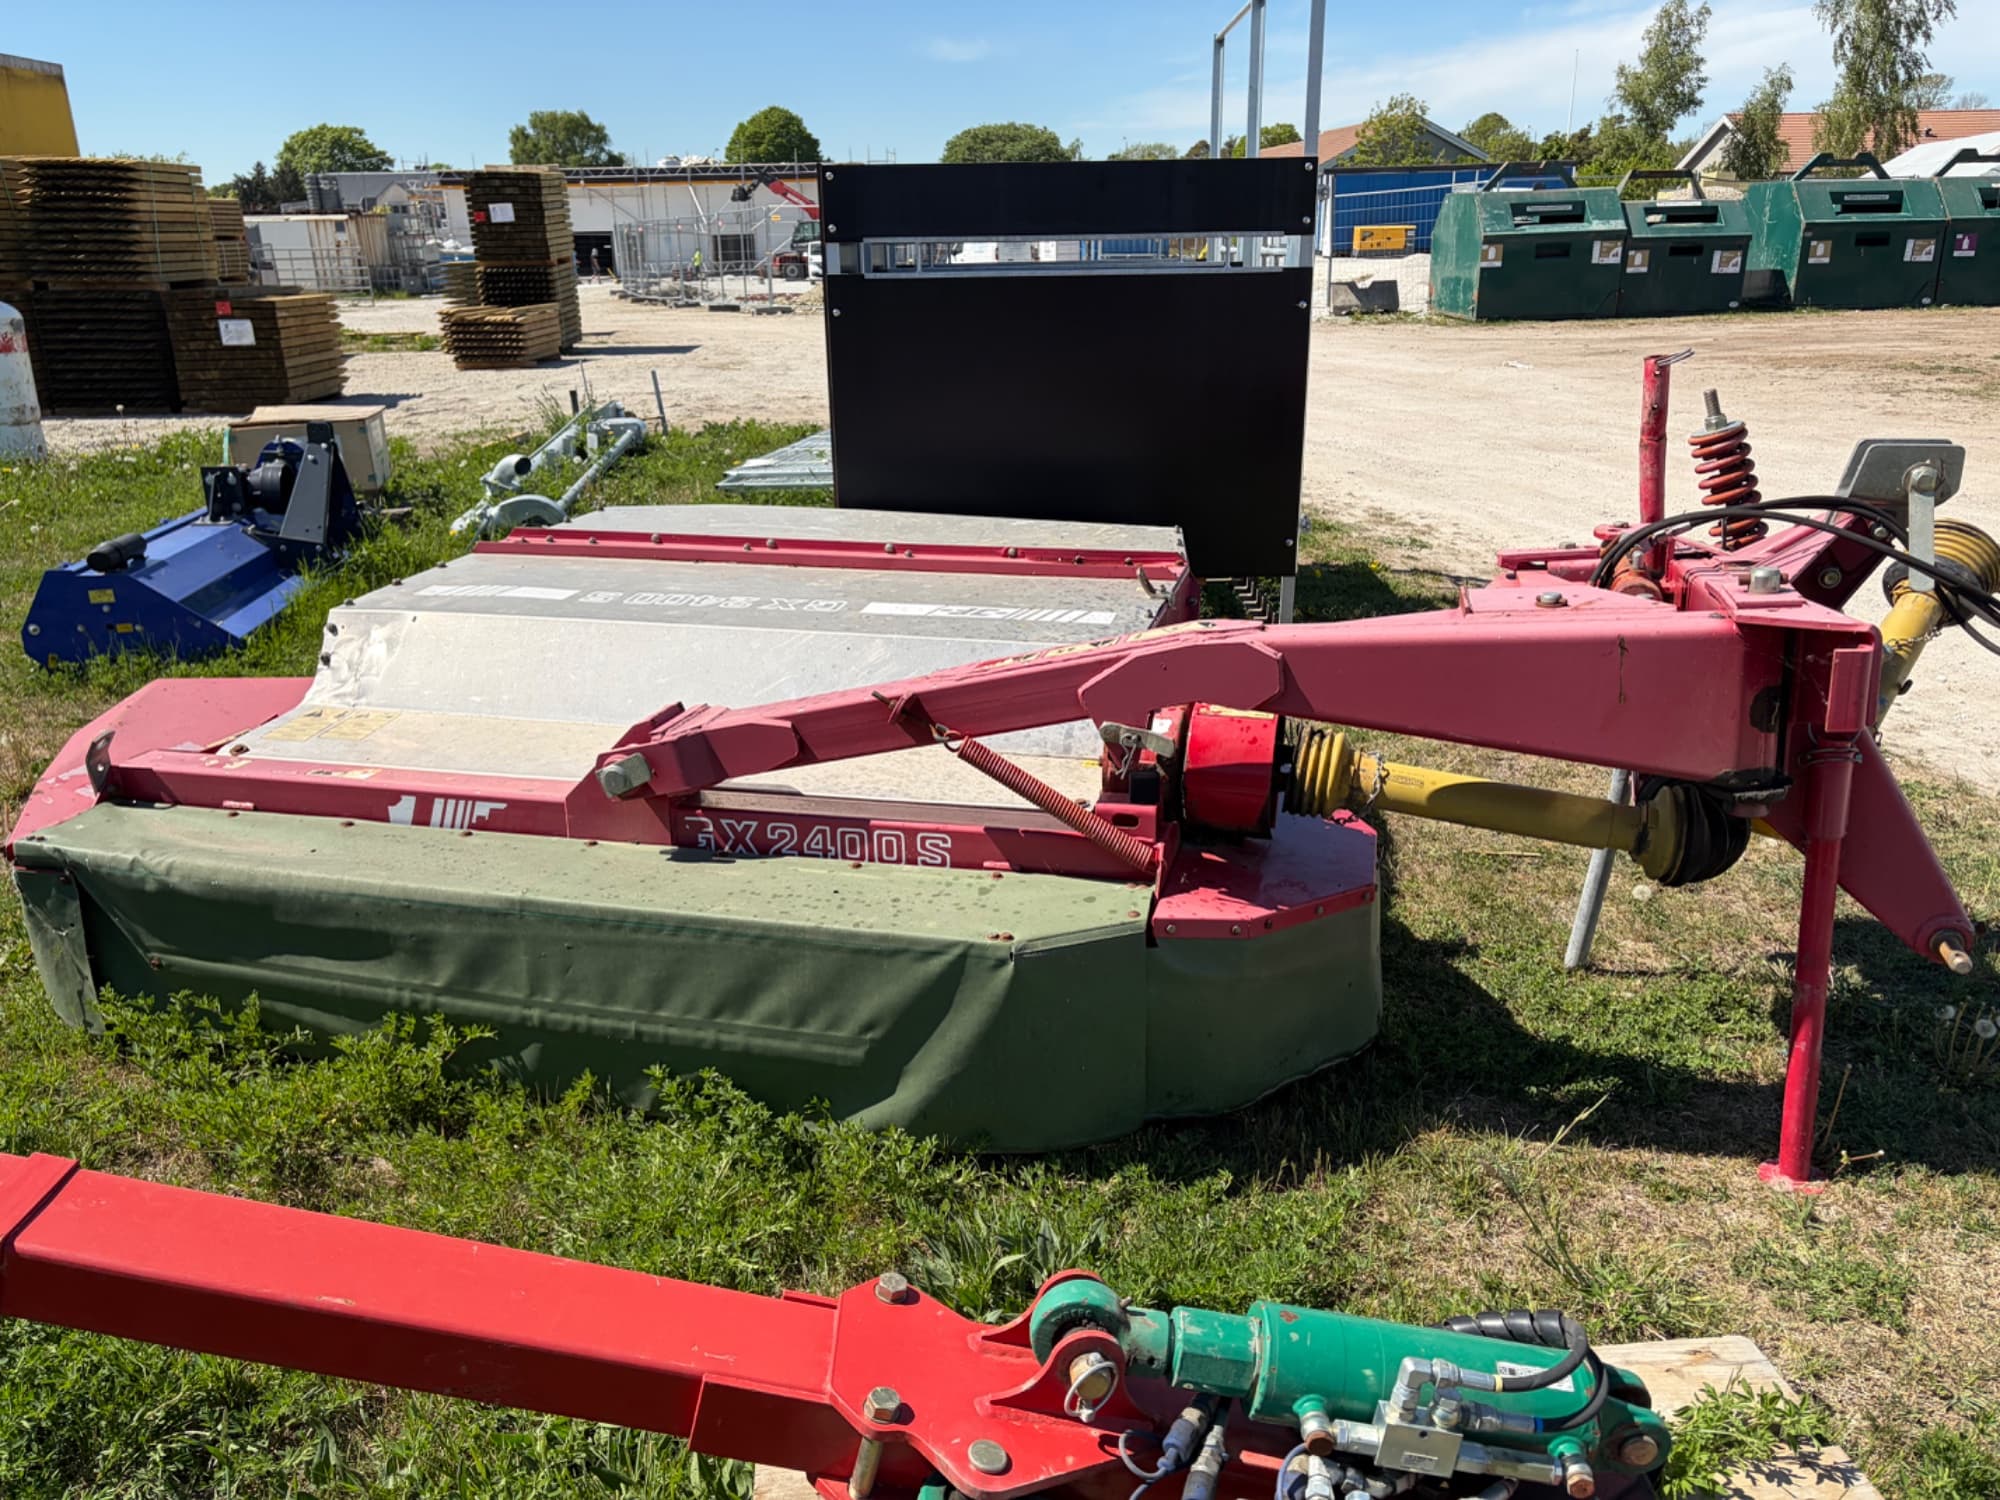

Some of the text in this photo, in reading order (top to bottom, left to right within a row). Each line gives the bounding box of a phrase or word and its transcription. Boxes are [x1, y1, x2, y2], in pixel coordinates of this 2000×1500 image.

[577, 590, 624, 604] S
[622, 591, 761, 609] 2400
[766, 822, 906, 866] 2400
[916, 831, 952, 868] S
